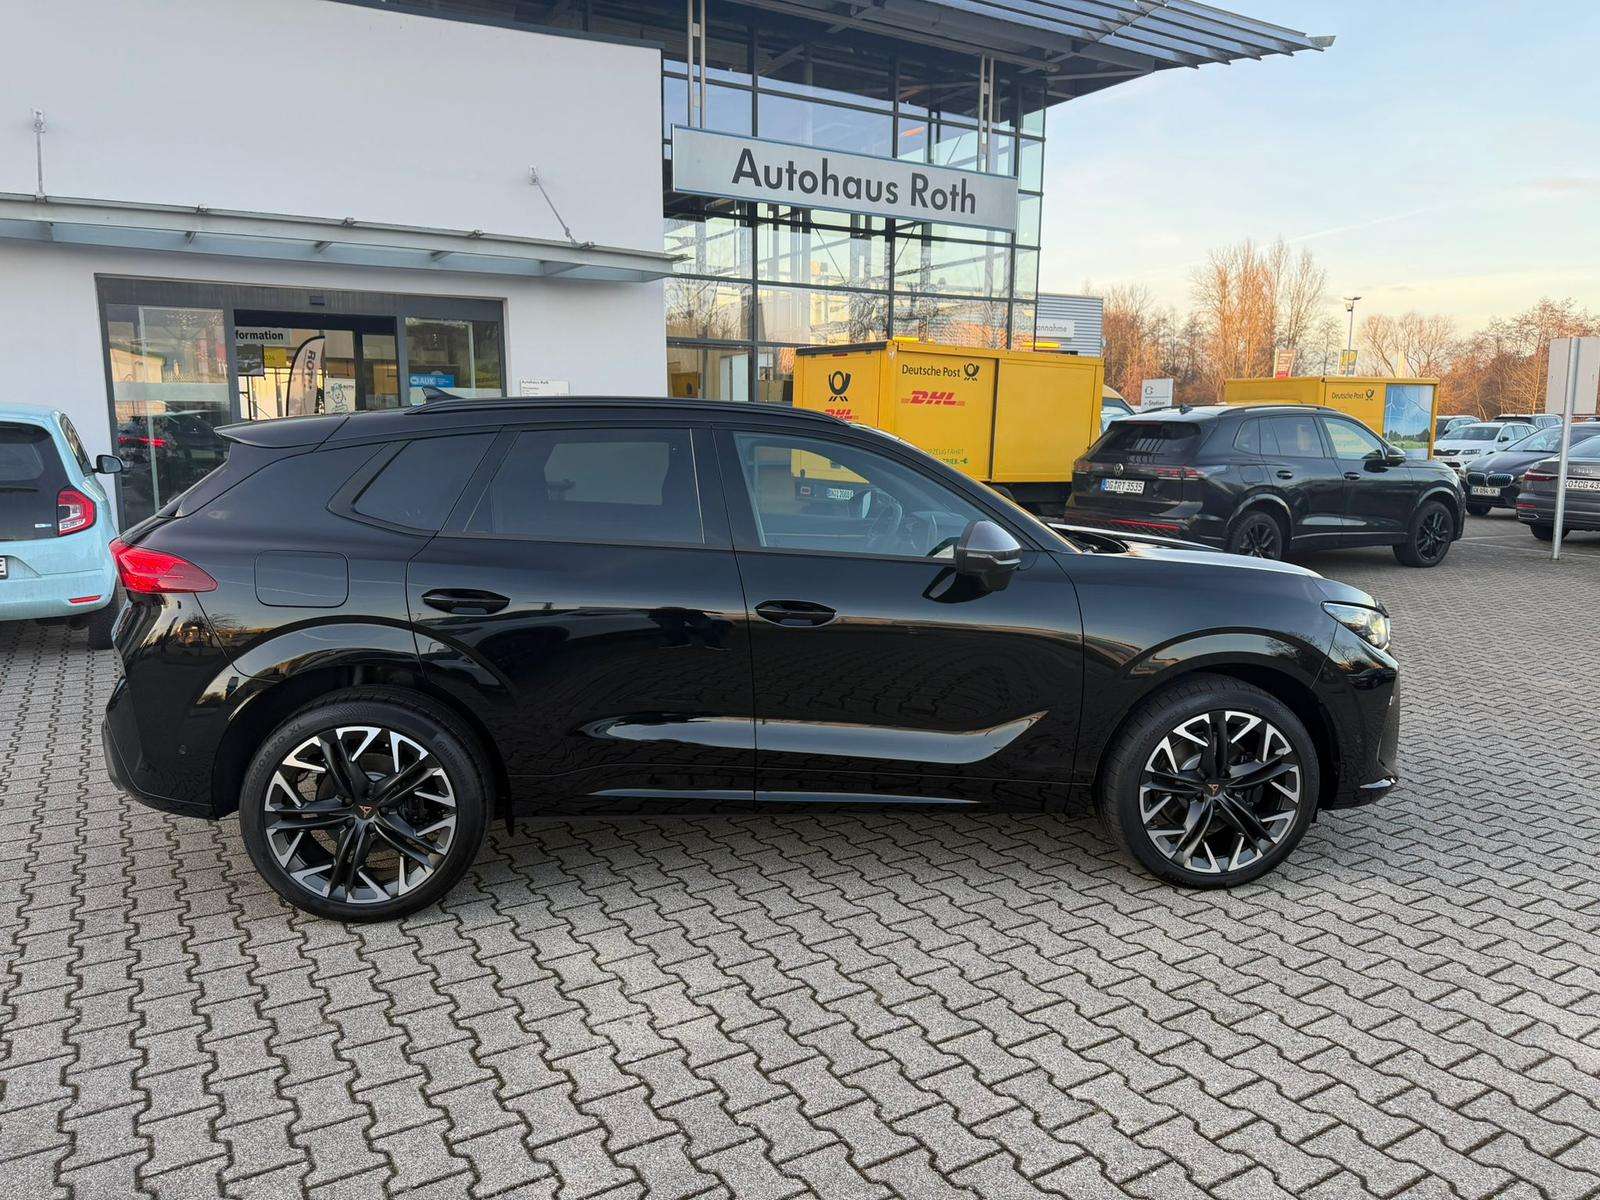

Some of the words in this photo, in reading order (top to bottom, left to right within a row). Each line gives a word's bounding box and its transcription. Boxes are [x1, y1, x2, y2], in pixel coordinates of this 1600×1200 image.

[731, 147, 899, 205] Autohaus
[910, 171, 976, 214] Roth
[902, 364, 941, 377] Deutsche
[942, 366, 960, 378] Post
[910, 390, 957, 406] DHL
